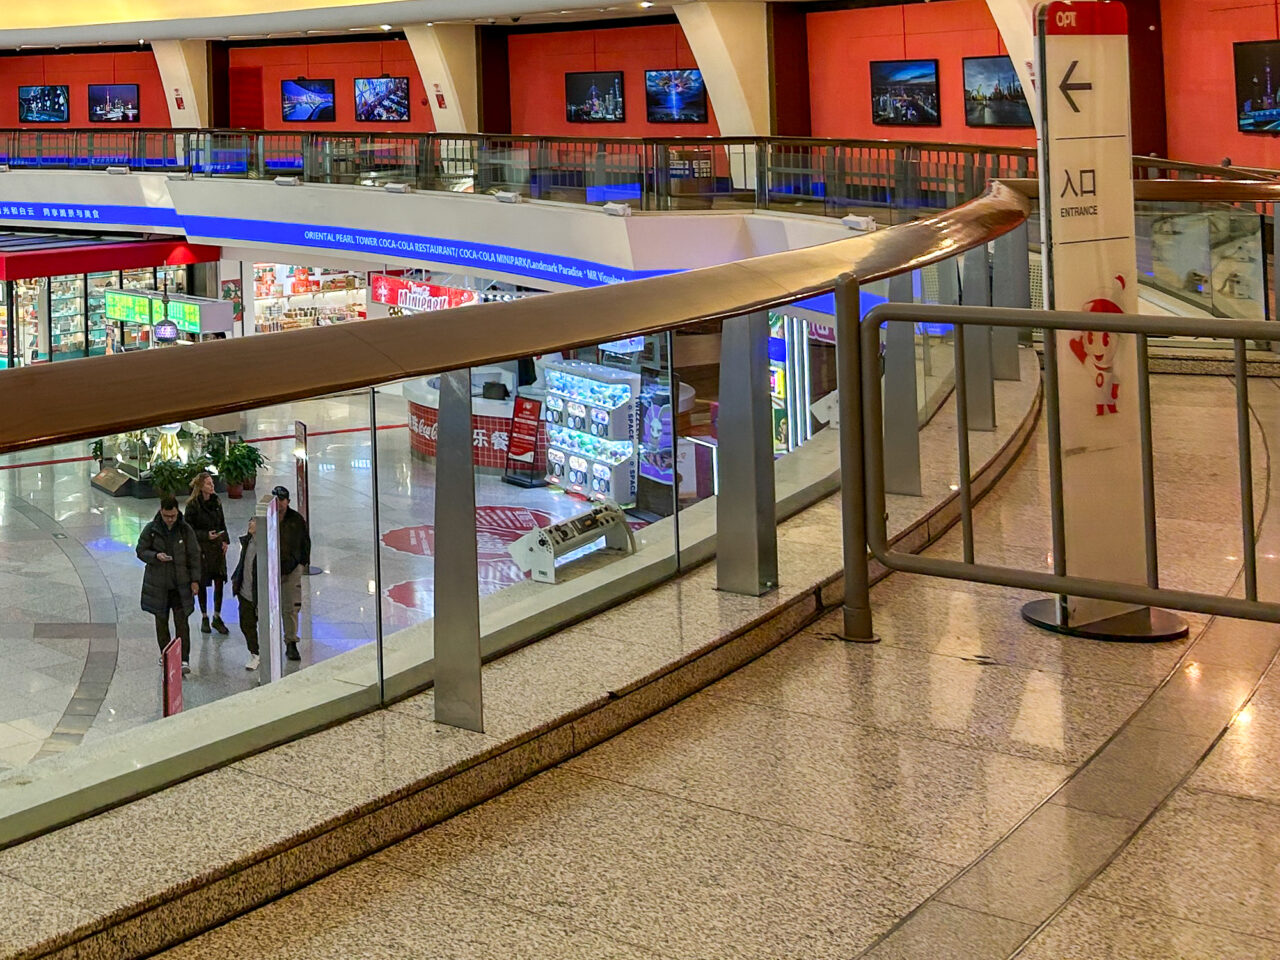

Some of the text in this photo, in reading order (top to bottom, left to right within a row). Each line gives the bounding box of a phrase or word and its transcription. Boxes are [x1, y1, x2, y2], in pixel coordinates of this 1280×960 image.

[1060, 169, 1096, 198] 入口
[1060, 205, 1098, 218] ENTRANCE
[304, 230, 335, 242] ORIENTAL
[335, 234, 355, 244] PEARL
[355, 236, 378, 246] TOWER
[378, 239, 414, 251] COCA-COLA
[459, 249, 495, 262] COCA-COLA
[558, 264, 583, 278] Paradise
